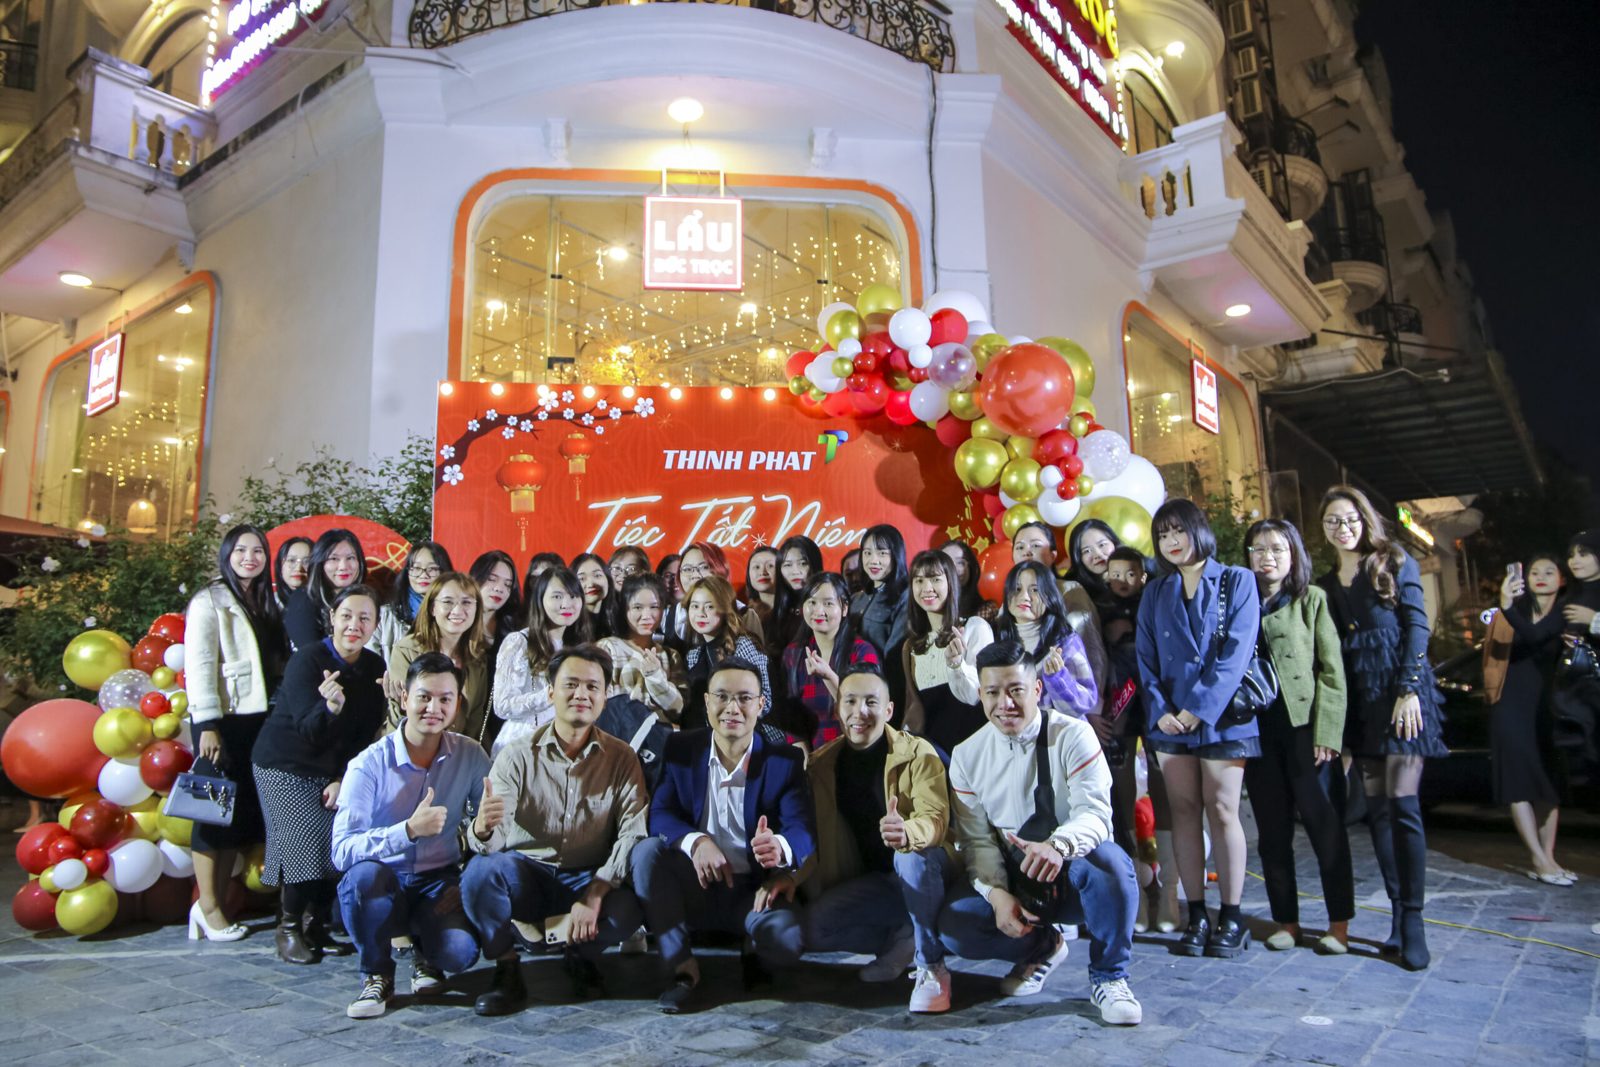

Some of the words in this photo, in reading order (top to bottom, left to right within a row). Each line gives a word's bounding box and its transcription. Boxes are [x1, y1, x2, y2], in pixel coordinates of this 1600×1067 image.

[653, 209, 733, 253] LẨU
[663, 449, 744, 470] THINH
[748, 450, 817, 471] PHAT
[678, 496, 757, 556] Tất
